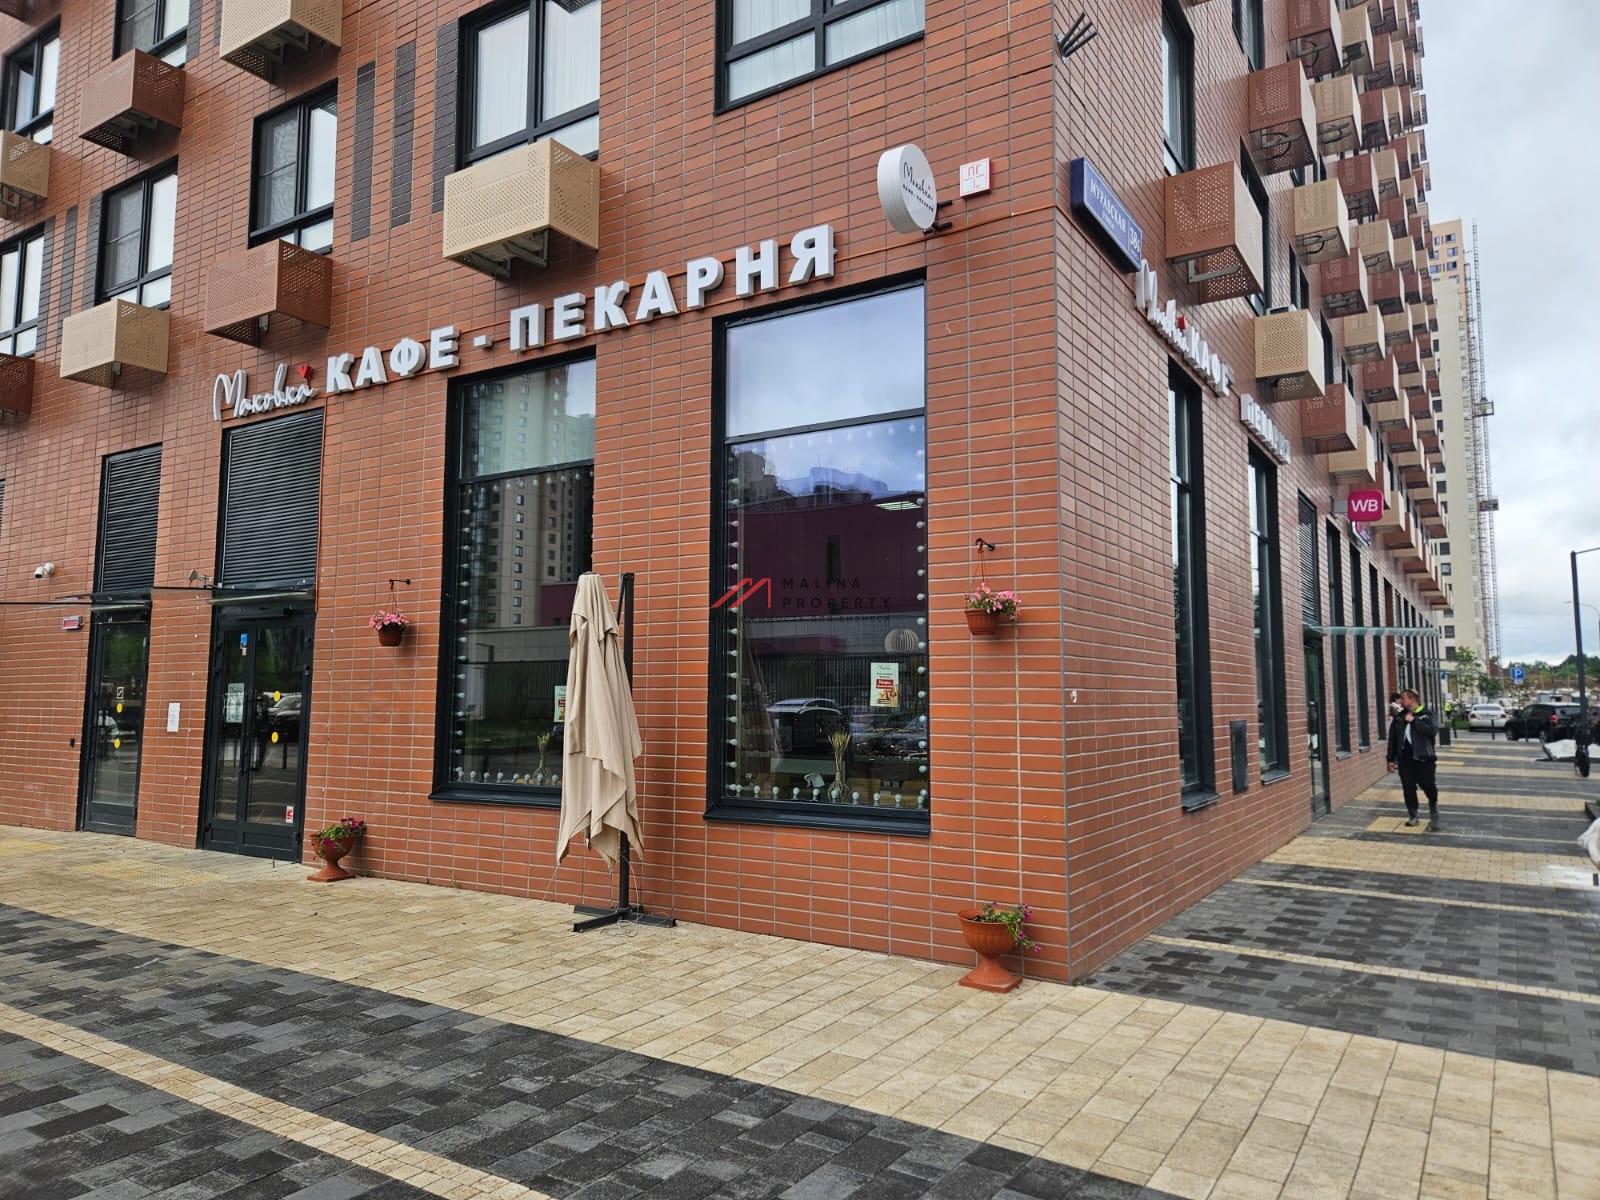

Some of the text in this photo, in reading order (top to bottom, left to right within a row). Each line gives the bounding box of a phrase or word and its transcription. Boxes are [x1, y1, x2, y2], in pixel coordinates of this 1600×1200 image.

[967, 164, 983, 178] ПГ
[1090, 178, 1126, 233] МУРАВСКАЯ
[213, 363, 318, 421] Маковка
[326, 325, 460, 393] КАФЕ
[510, 224, 836, 351] ПЕКАРНЯ
[1184, 326, 1235, 397] КАФЕ
[1350, 499, 1379, 512] WB
